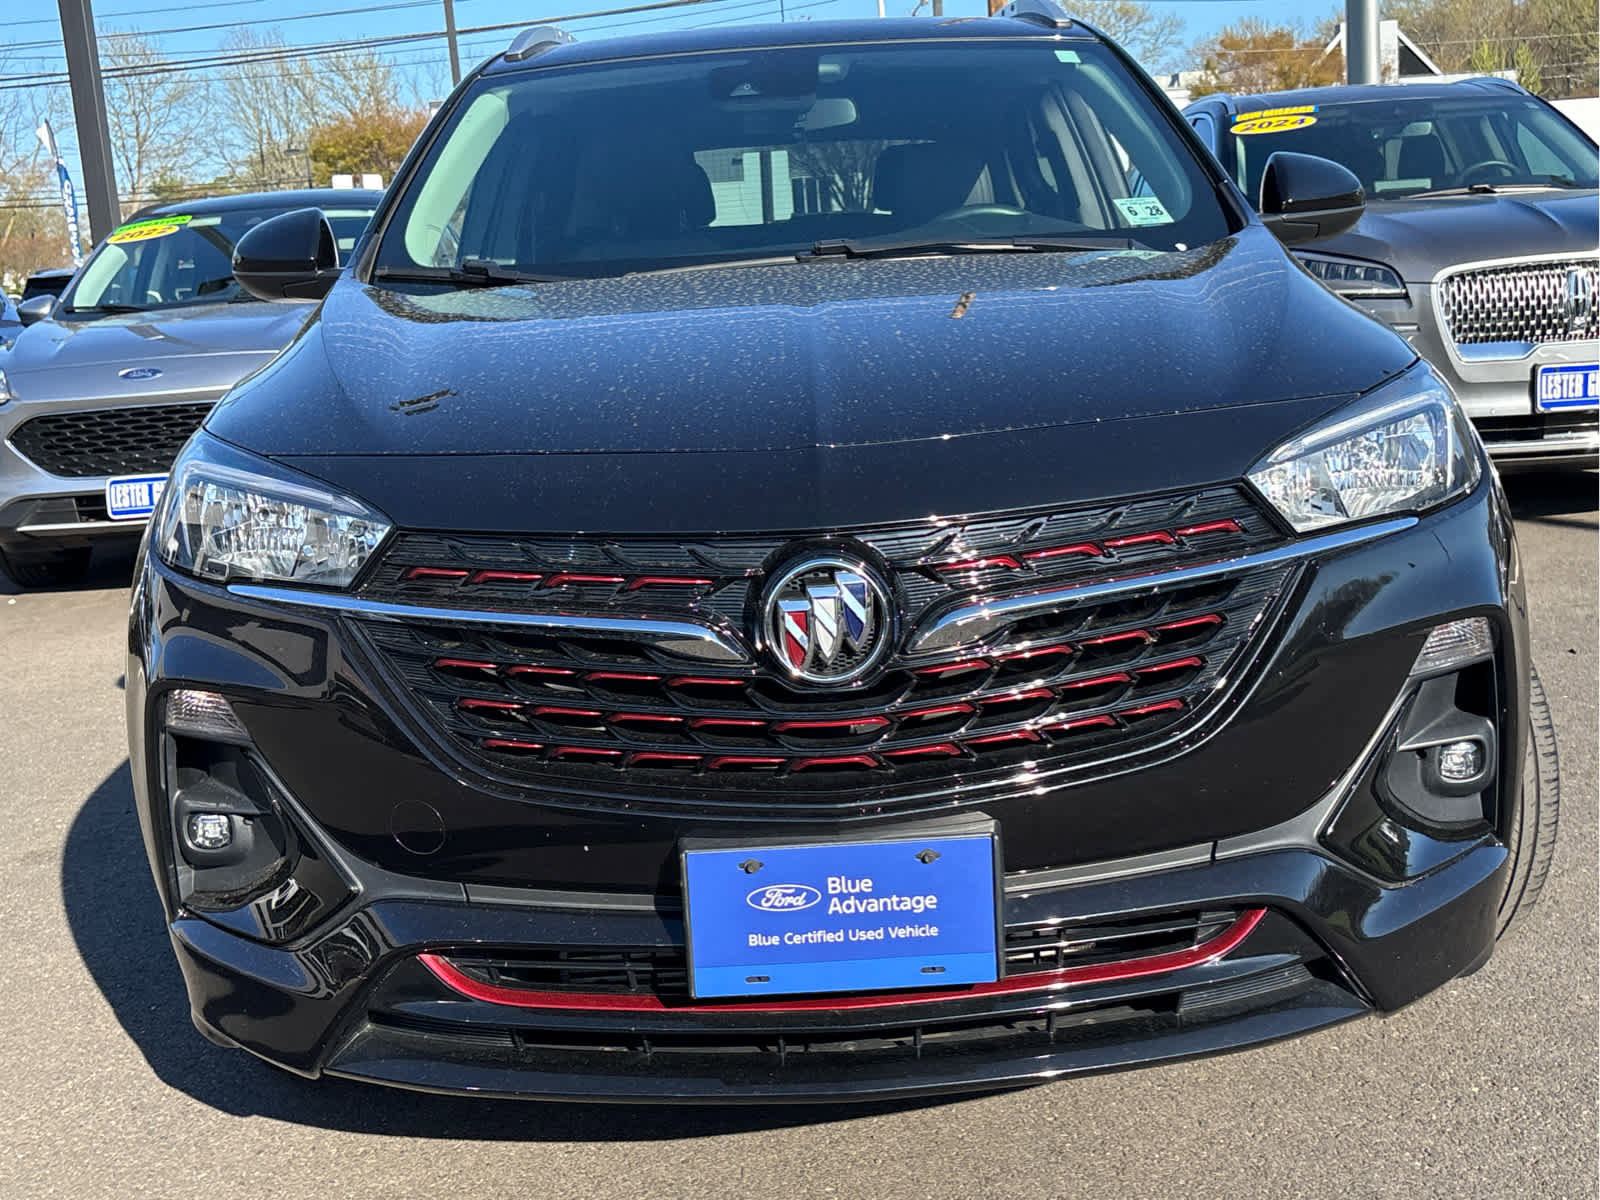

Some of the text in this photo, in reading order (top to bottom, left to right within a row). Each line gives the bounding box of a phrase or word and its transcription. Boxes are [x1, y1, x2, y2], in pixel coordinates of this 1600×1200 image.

[1240, 118, 1306, 132] 2024
[1127, 205, 1164, 216] 6 28
[116, 226, 173, 241] 2022
[1542, 373, 1583, 400] LESTER
[111, 484, 150, 507] LESTER
[827, 875, 873, 895] Blue
[761, 888, 807, 907] Ford
[827, 895, 938, 915] Advantage
[748, 924, 939, 946] Blue Certified Used Vehicle
